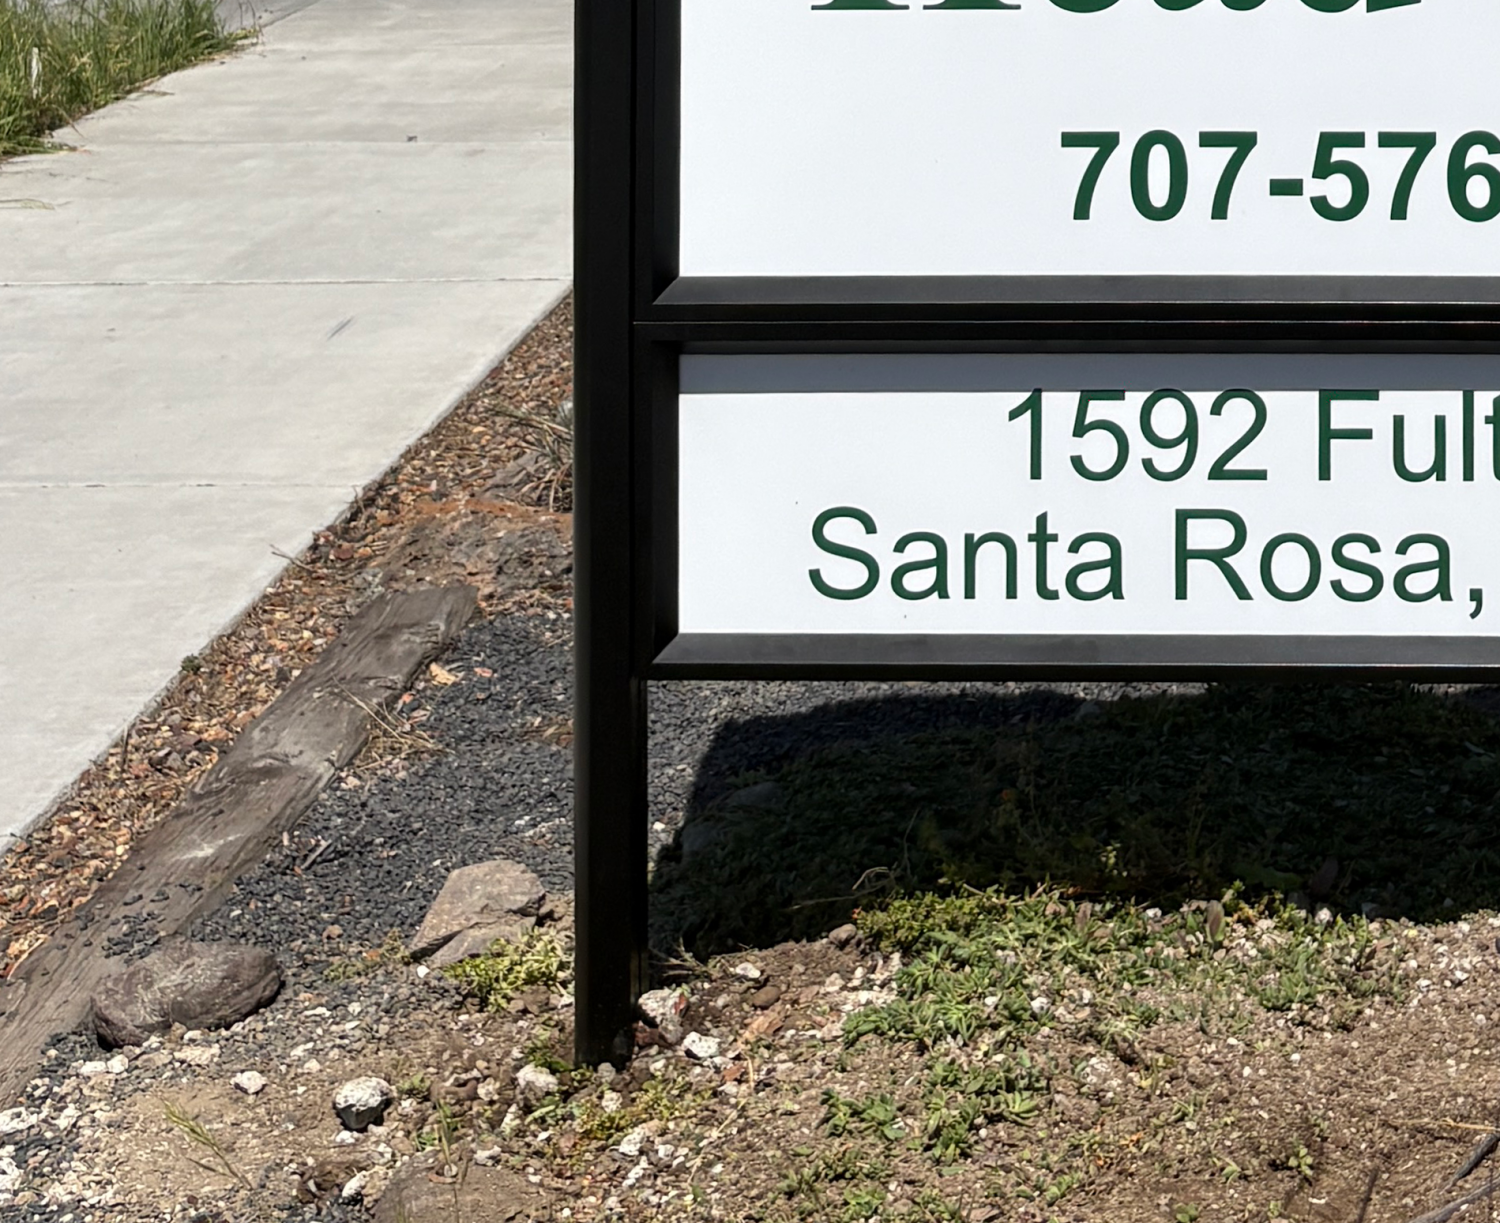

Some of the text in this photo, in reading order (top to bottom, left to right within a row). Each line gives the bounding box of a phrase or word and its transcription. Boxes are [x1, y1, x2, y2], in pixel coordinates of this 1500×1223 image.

[1008, 387, 1268, 481] 1592
[809, 506, 1125, 601] Santa
[1175, 508, 1482, 619] Rosa,
